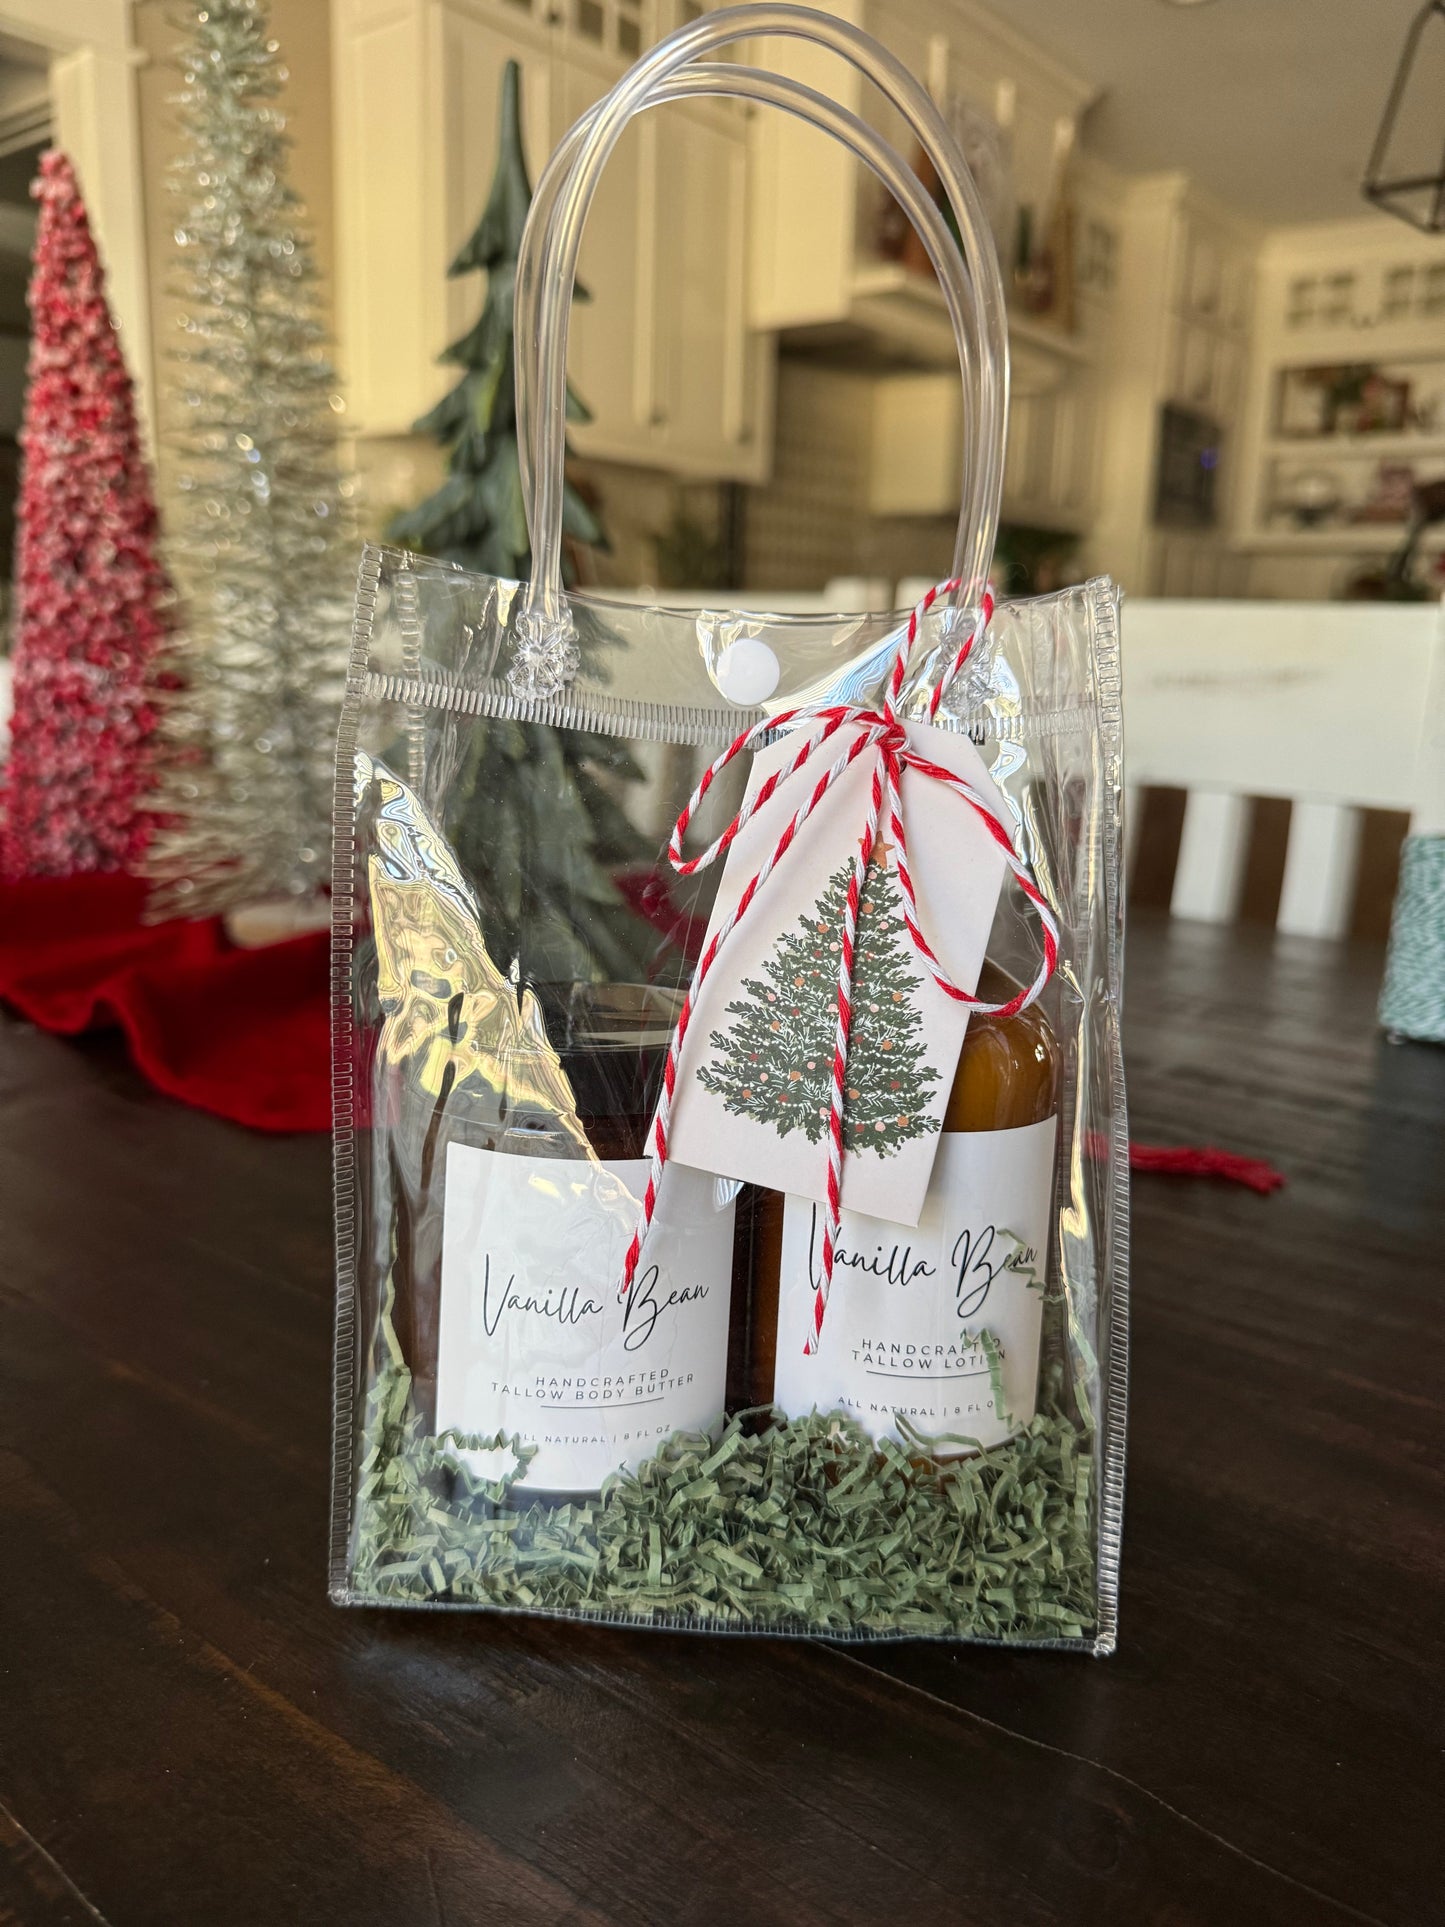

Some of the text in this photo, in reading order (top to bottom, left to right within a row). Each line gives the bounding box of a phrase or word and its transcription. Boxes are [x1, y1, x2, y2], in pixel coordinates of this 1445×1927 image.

[809, 1202, 1038, 1318] Vanilla Bean
[483, 1253, 710, 1351] Vanilla Bean
[861, 1337, 1001, 1356] HANDCRAFTD
[851, 1349, 1006, 1369] TALLOW LOTIN
[491, 1373, 694, 1400] TALLOW BODY BUTTER
[536, 1368, 669, 1388] HANDCRAFTED
[838, 1396, 862, 1409] ALL
[870, 1402, 936, 1416] NATURAL
[954, 1406, 961, 1414] 8
[967, 1404, 981, 1412] FL
[544, 1435, 606, 1444] NATURAL
[624, 1432, 630, 1440] 8
[637, 1430, 649, 1438] FL
[656, 1424, 671, 1434] OZ
